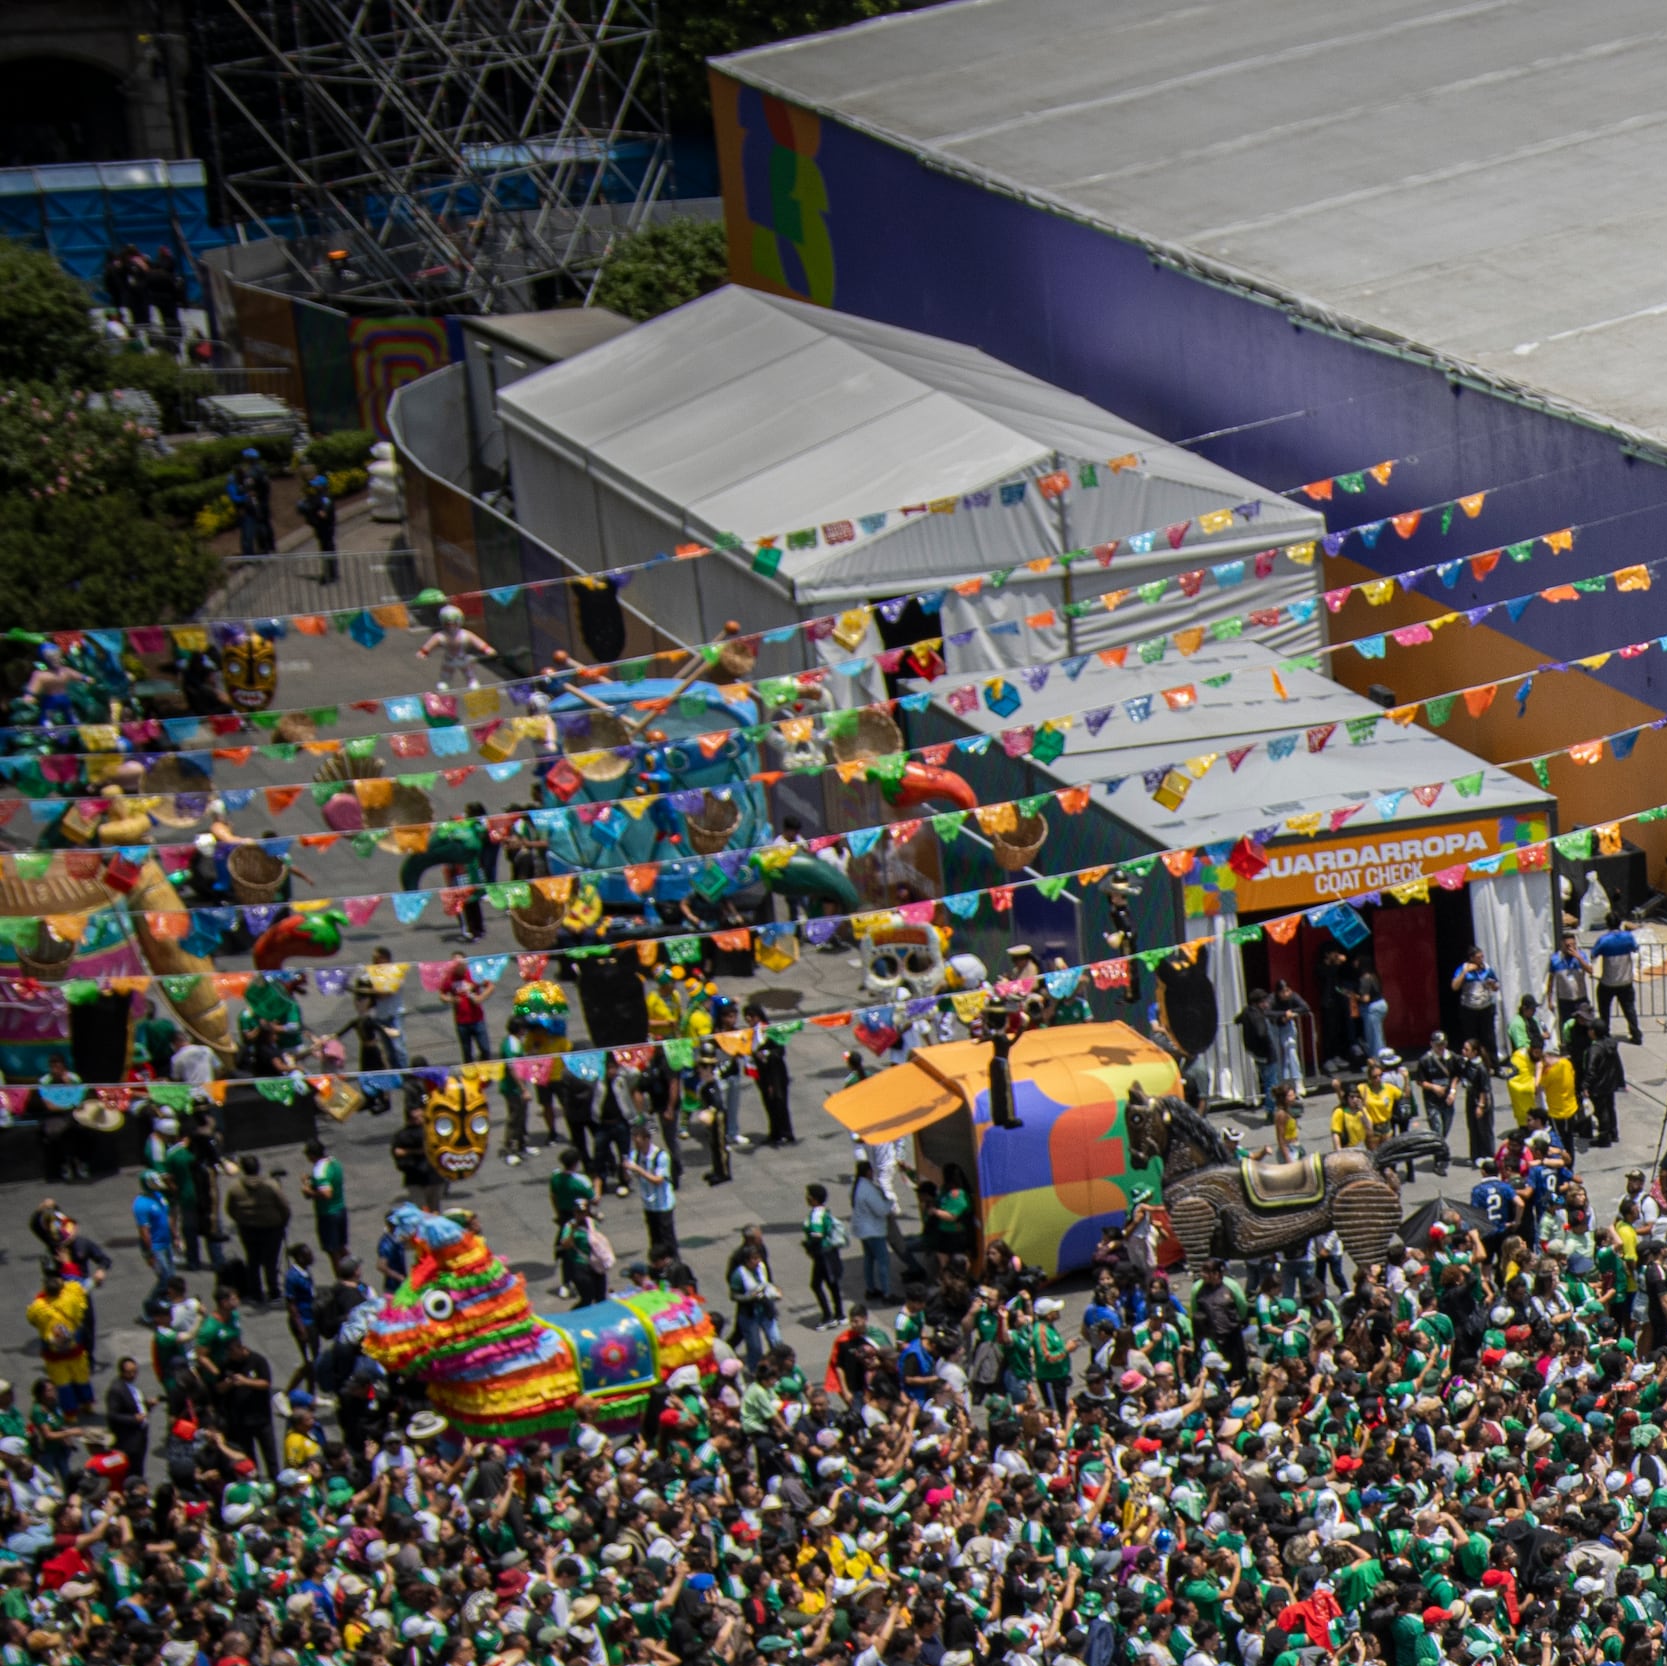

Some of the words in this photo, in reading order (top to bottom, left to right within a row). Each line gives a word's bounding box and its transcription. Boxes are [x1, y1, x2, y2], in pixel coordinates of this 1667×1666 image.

[1315, 868, 1365, 894] COAT
[1368, 861, 1424, 886] CHECK
[1487, 1194, 1502, 1220] 2
